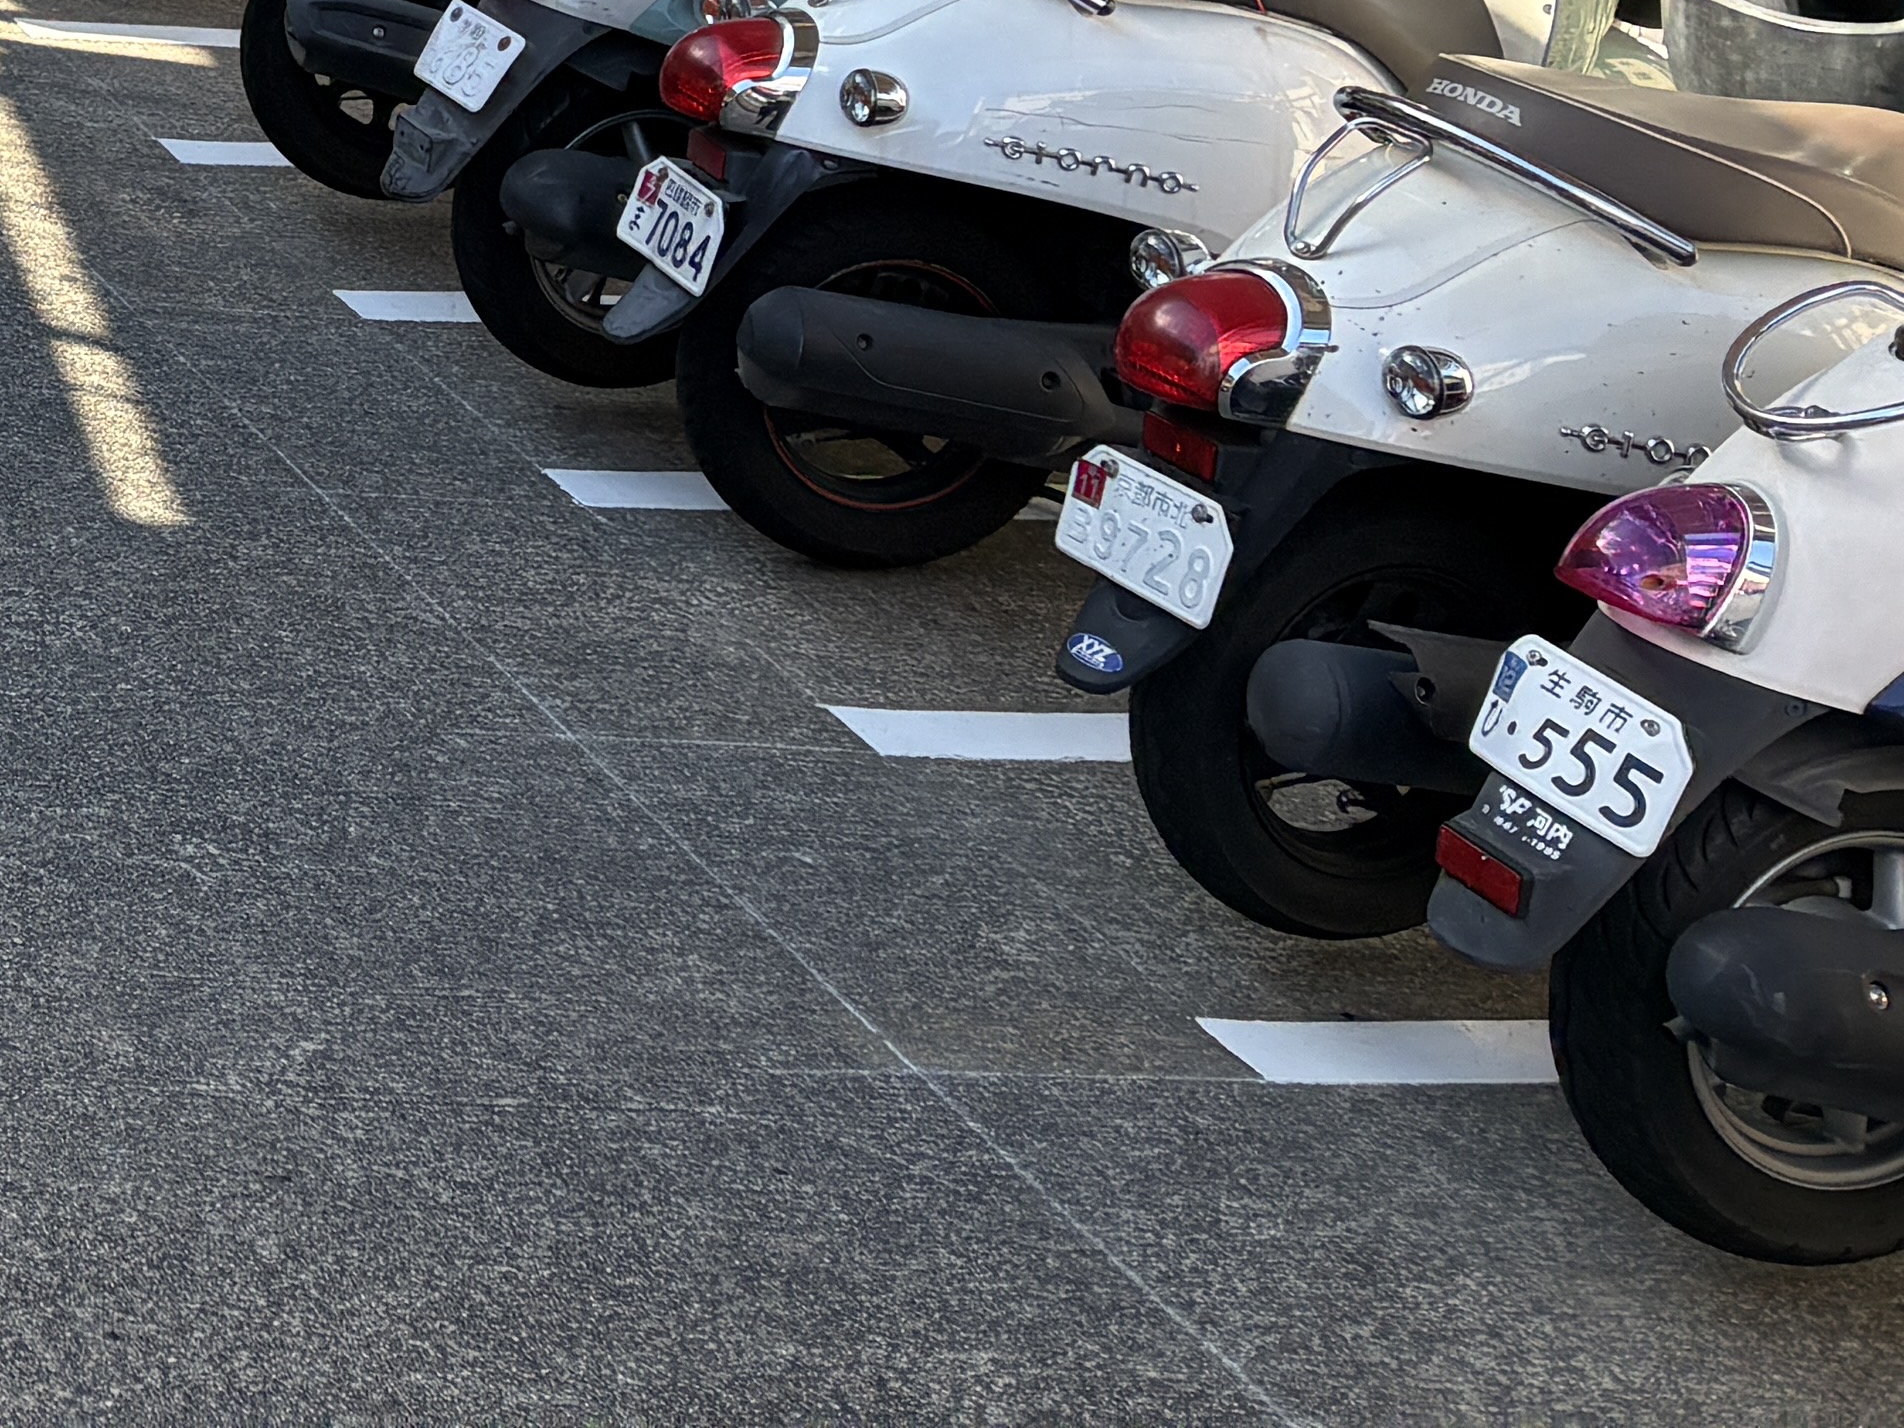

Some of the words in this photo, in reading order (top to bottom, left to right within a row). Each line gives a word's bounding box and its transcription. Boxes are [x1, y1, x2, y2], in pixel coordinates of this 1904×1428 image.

[1426, 78, 1523, 127] HONDA
[644, 199, 712, 282] 7084
[1093, 508, 1212, 609] 9728
[1539, 667, 1635, 733] 生駒市
[1499, 785, 1573, 850] SP河内
